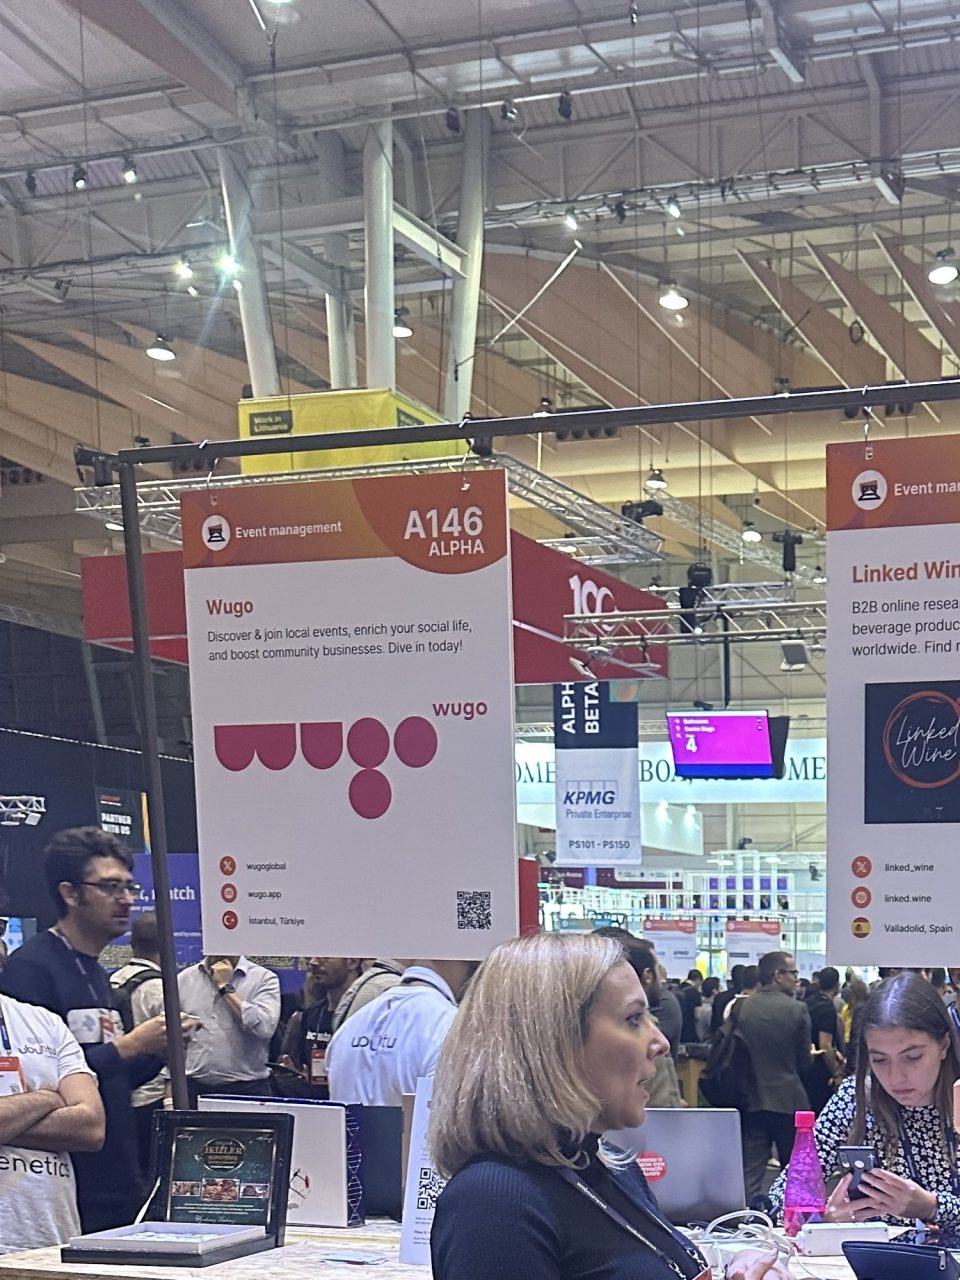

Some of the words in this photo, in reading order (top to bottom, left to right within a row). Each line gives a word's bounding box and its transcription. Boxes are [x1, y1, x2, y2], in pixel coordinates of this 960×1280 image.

[894, 482, 933, 496] Event
[236, 525, 267, 539] Event
[269, 520, 342, 537] management
[404, 506, 483, 540] A146
[429, 539, 484, 557] ALPHA
[853, 562, 918, 583] Linked
[207, 599, 253, 618] Wugo
[852, 600, 878, 614] B2B
[882, 598, 919, 613] online
[208, 629, 252, 642] Discover
[254, 629, 262, 641] &
[264, 627, 283, 642] join
[285, 626, 310, 639] local
[312, 625, 351, 639] events,
[354, 623, 387, 636] enrich
[390, 623, 414, 638] your
[418, 620, 450, 633] social
[452, 619, 472, 633] life,
[852, 619, 911, 637] beverage
[208, 649, 228, 661] and
[230, 647, 260, 660] boost
[262, 645, 319, 661] community
[323, 643, 384, 656] businesses.
[388, 641, 412, 654] Dive
[415, 641, 425, 653] in
[428, 639, 463, 655] today!
[852, 641, 920, 657] worldwide.
[925, 639, 952, 654] Find
[433, 702, 487, 720] wugo
[561, 682, 576, 734] ALPH
[584, 682, 600, 734] BETA
[686, 737, 697, 752] 4
[900, 737, 957, 768] Wine
[563, 790, 616, 805] KPMG
[101, 813, 131, 824] PARTNER
[565, 809, 592, 819] Private
[594, 809, 632, 820] Enterprise
[121, 825, 131, 835] US
[569, 841, 595, 849] PS101
[603, 841, 630, 849] PS150
[246, 862, 286, 872] wugoglobal
[884, 862, 934, 874] linked_wine
[248, 890, 282, 900] wugo.app
[884, 893, 932, 904] linked.wine
[280, 917, 305, 926] Türkiye
[884, 923, 927, 935] Valladolid,
[929, 923, 953, 935] Spain
